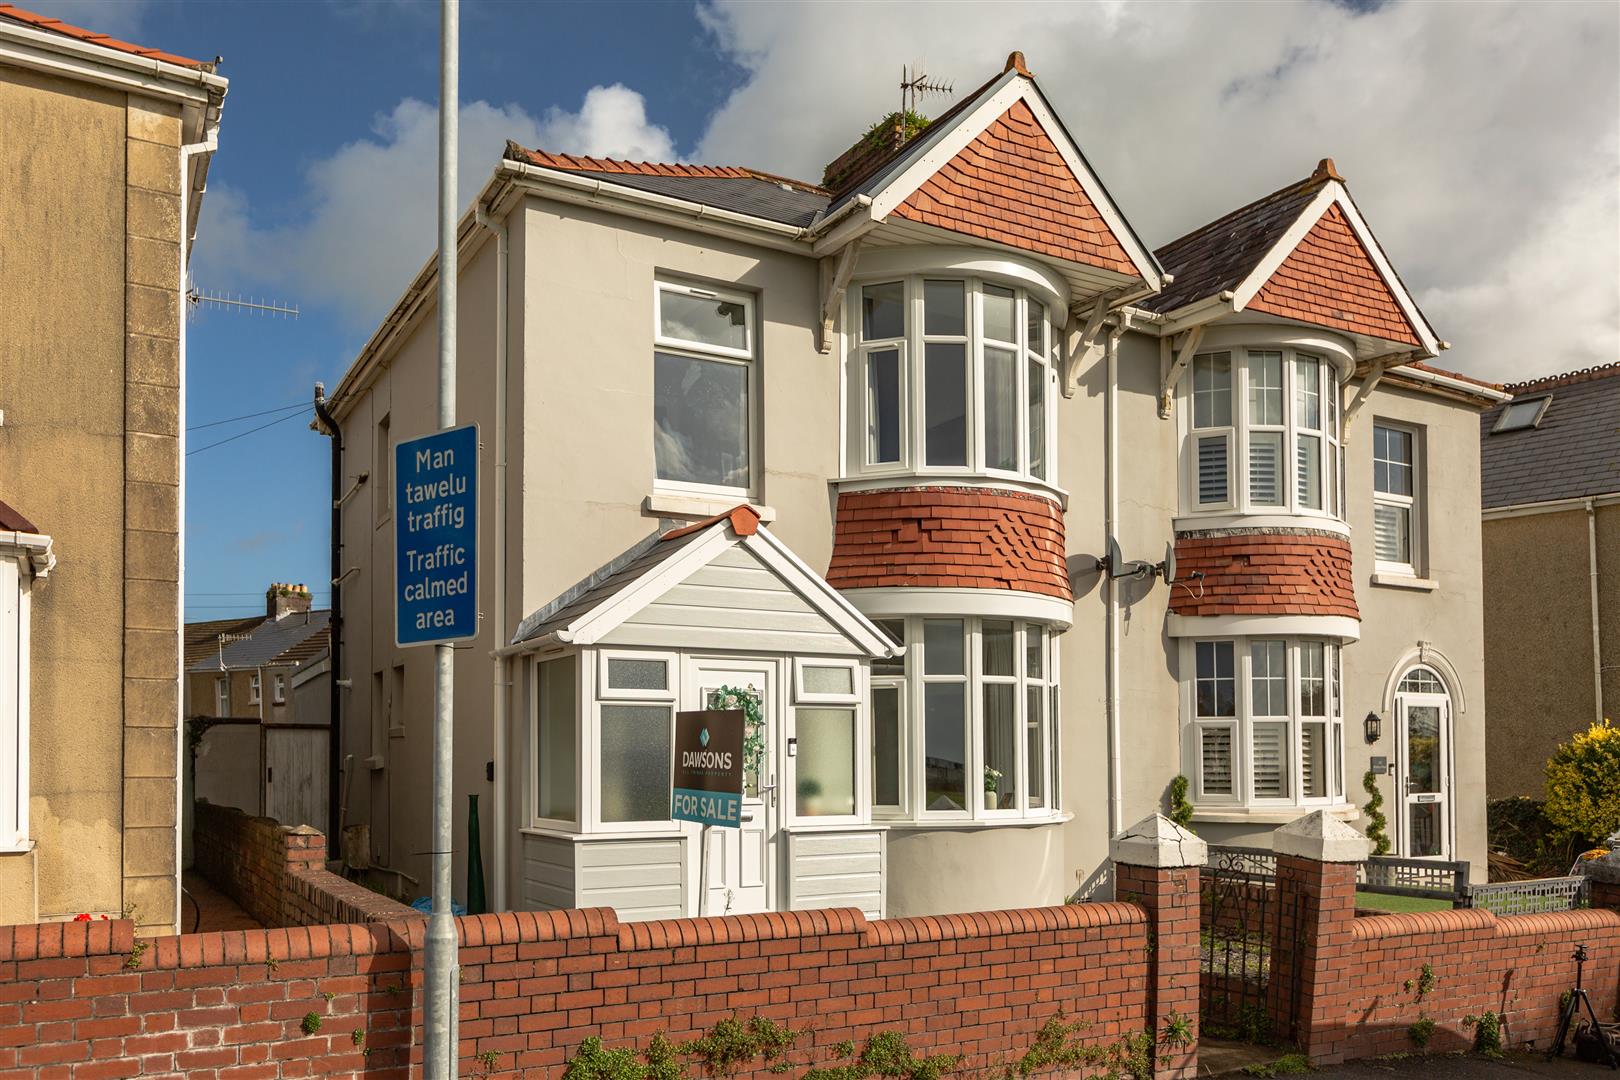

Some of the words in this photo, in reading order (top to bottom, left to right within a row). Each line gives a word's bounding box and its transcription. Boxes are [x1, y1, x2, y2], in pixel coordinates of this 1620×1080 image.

[416, 448, 454, 473] Man
[405, 473, 466, 503] tawelu
[408, 503, 464, 532] traffig
[406, 544, 465, 573] Traffic
[404, 571, 468, 602] calmed
[416, 608, 455, 629] area
[682, 751, 732, 770] DAWSONS
[674, 794, 698, 816] FOR
[700, 796, 737, 821] SALE
